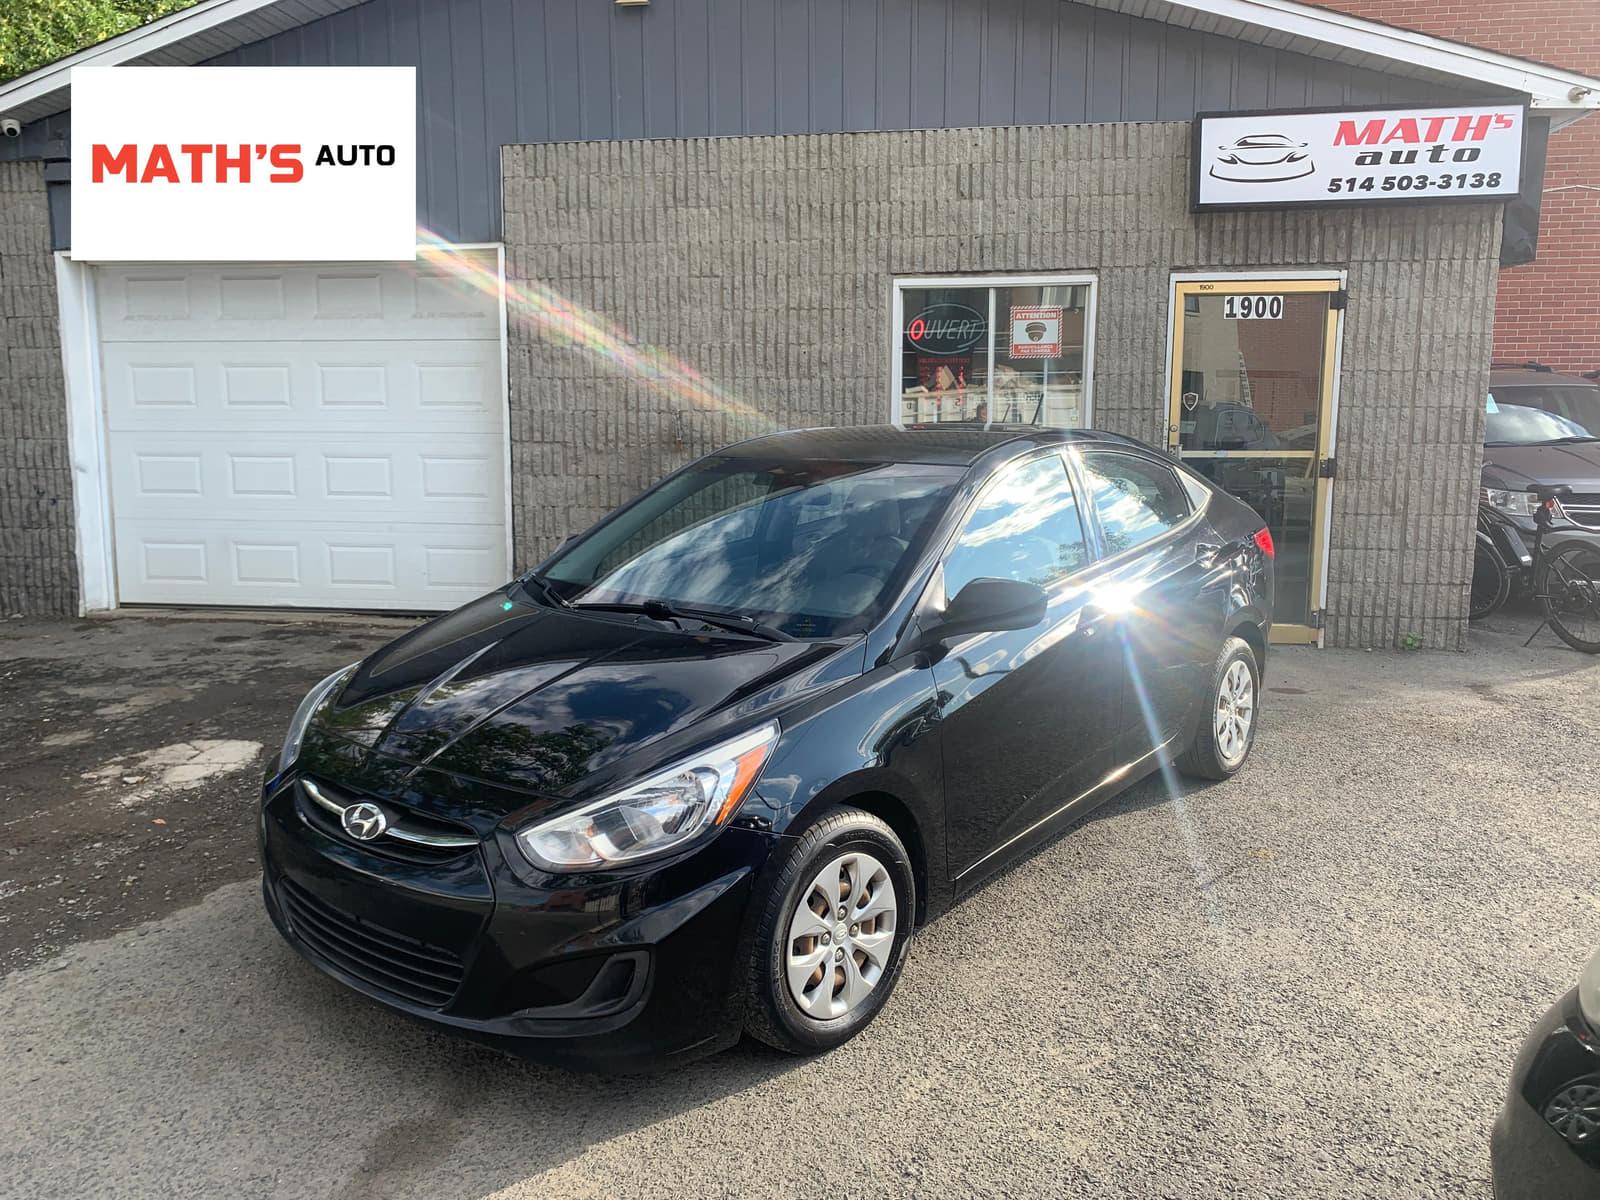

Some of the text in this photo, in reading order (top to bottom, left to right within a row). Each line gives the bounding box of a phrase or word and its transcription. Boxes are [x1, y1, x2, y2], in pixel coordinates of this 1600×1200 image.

[1354, 144, 1482, 166] auto
[1327, 172, 1503, 193] 514 503-3138
[1015, 311, 1057, 320] ATTENTION
[1224, 296, 1282, 318] 1900
[910, 319, 979, 341] OUVERT
